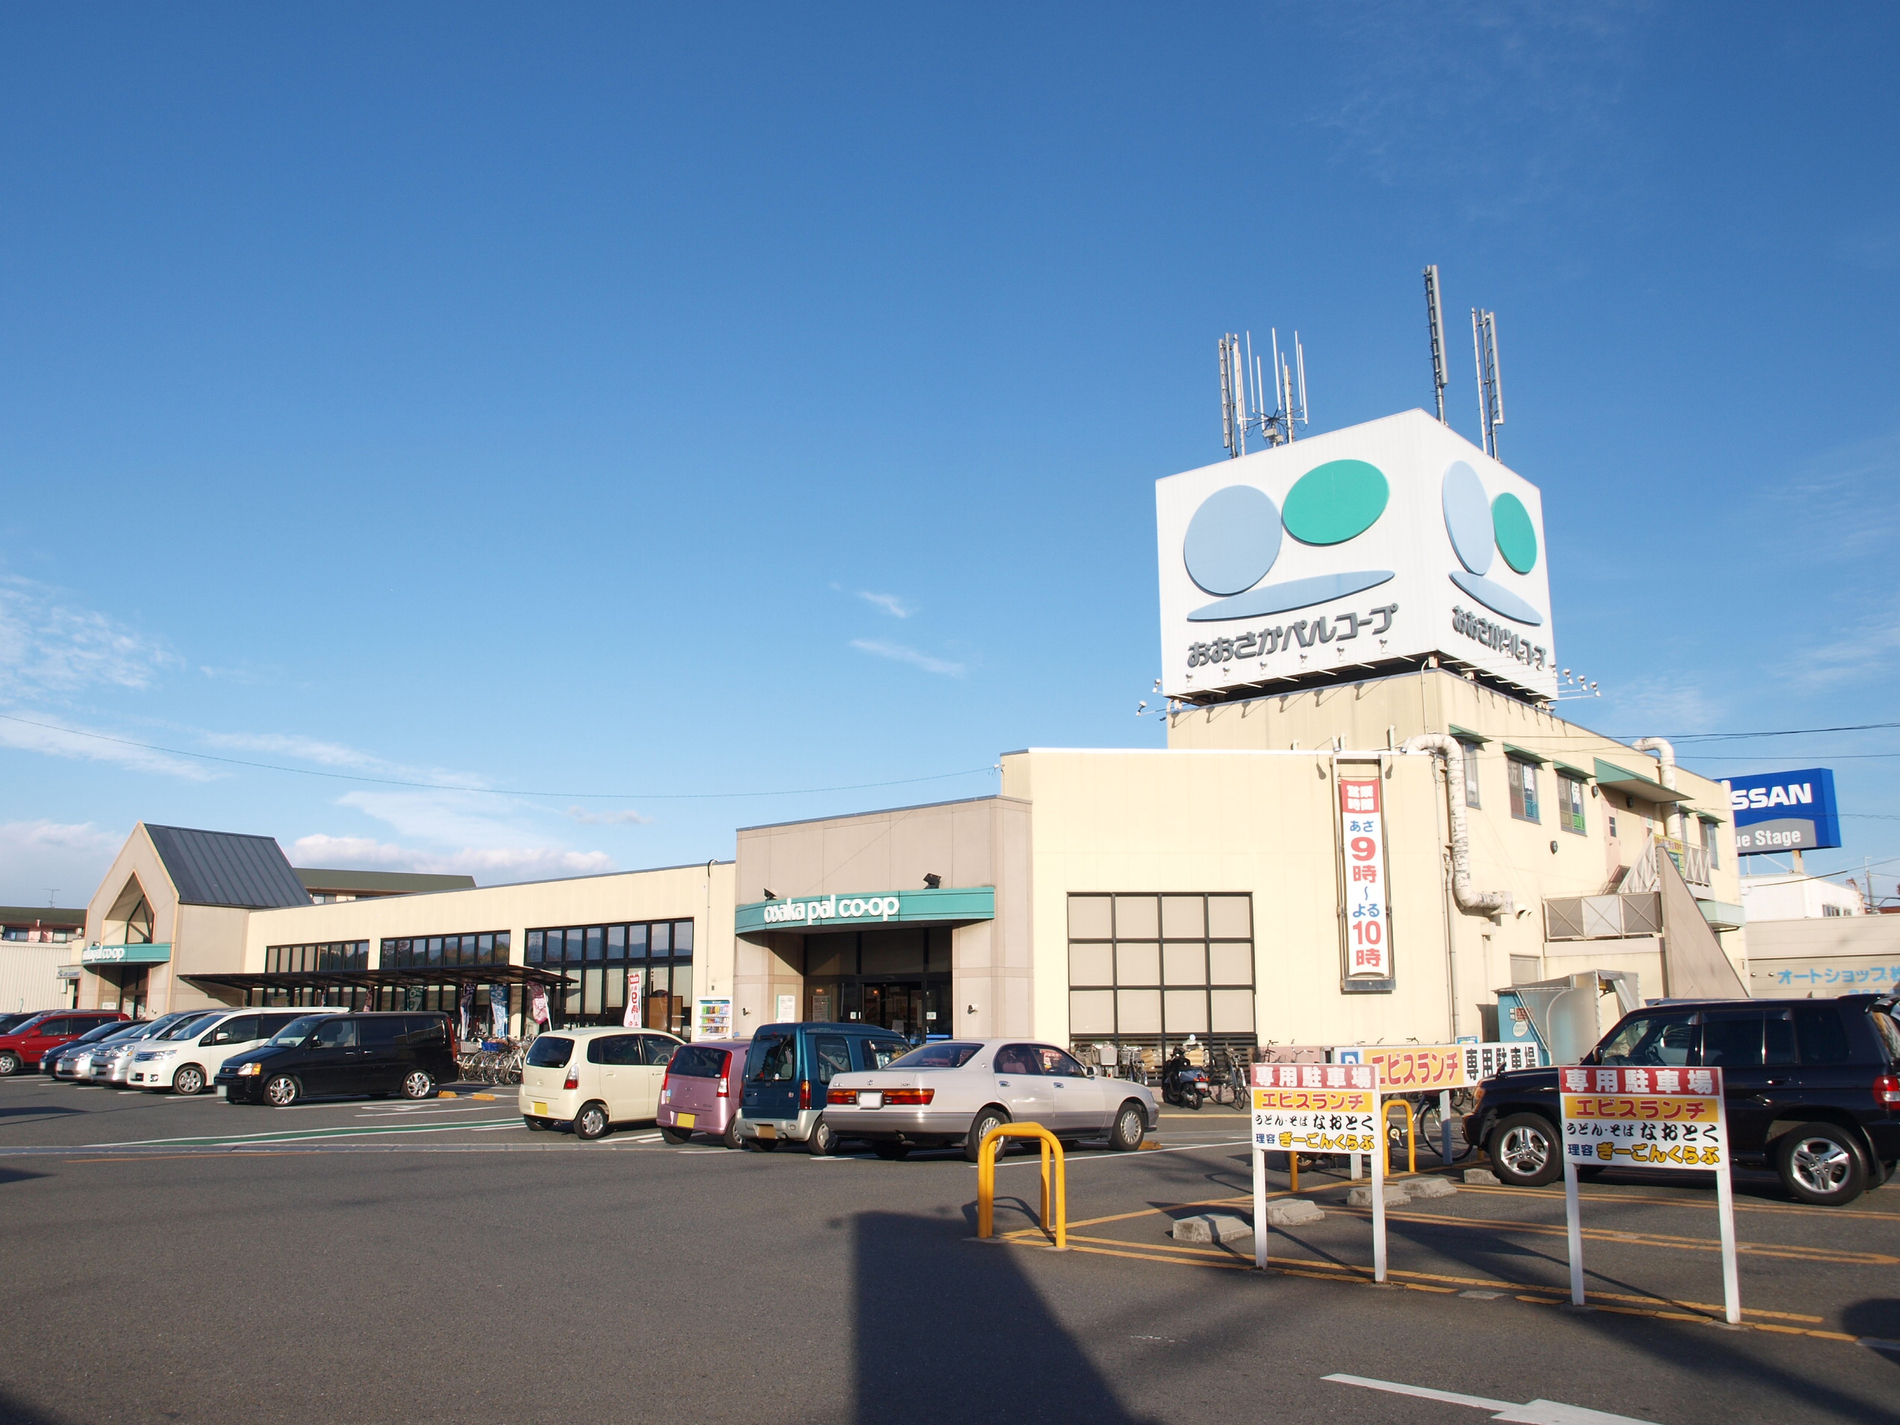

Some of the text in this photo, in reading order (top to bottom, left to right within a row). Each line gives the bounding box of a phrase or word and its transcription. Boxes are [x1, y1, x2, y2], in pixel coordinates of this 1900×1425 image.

[1187, 602, 1399, 668] おおさかパルコープ
[1452, 605, 1546, 669] おおさかパルコープ
[1731, 783, 1812, 810] SSAN
[1736, 830, 1801, 848] ue Stage
[764, 898, 806, 923] osaka
[807, 894, 836, 925] pal
[1255, 1066, 1372, 1088] 専用駐車場
[1372, 1047, 1536, 1086] エビスランチ 専用駐車場
[1565, 1069, 1713, 1094] 専用駐車場
[1262, 1092, 1364, 1111] エビスランチ
[1576, 1099, 1706, 1120] エビスランチ
[1255, 1114, 1374, 1131] うどん・そば なおとく
[1566, 1122, 1719, 1143] うどん・そば なおとく
[1256, 1131, 1375, 1151] 理容 ぎーごんくらぶ
[1567, 1141, 1720, 1165] 理容 ぎーごんくらぶ
